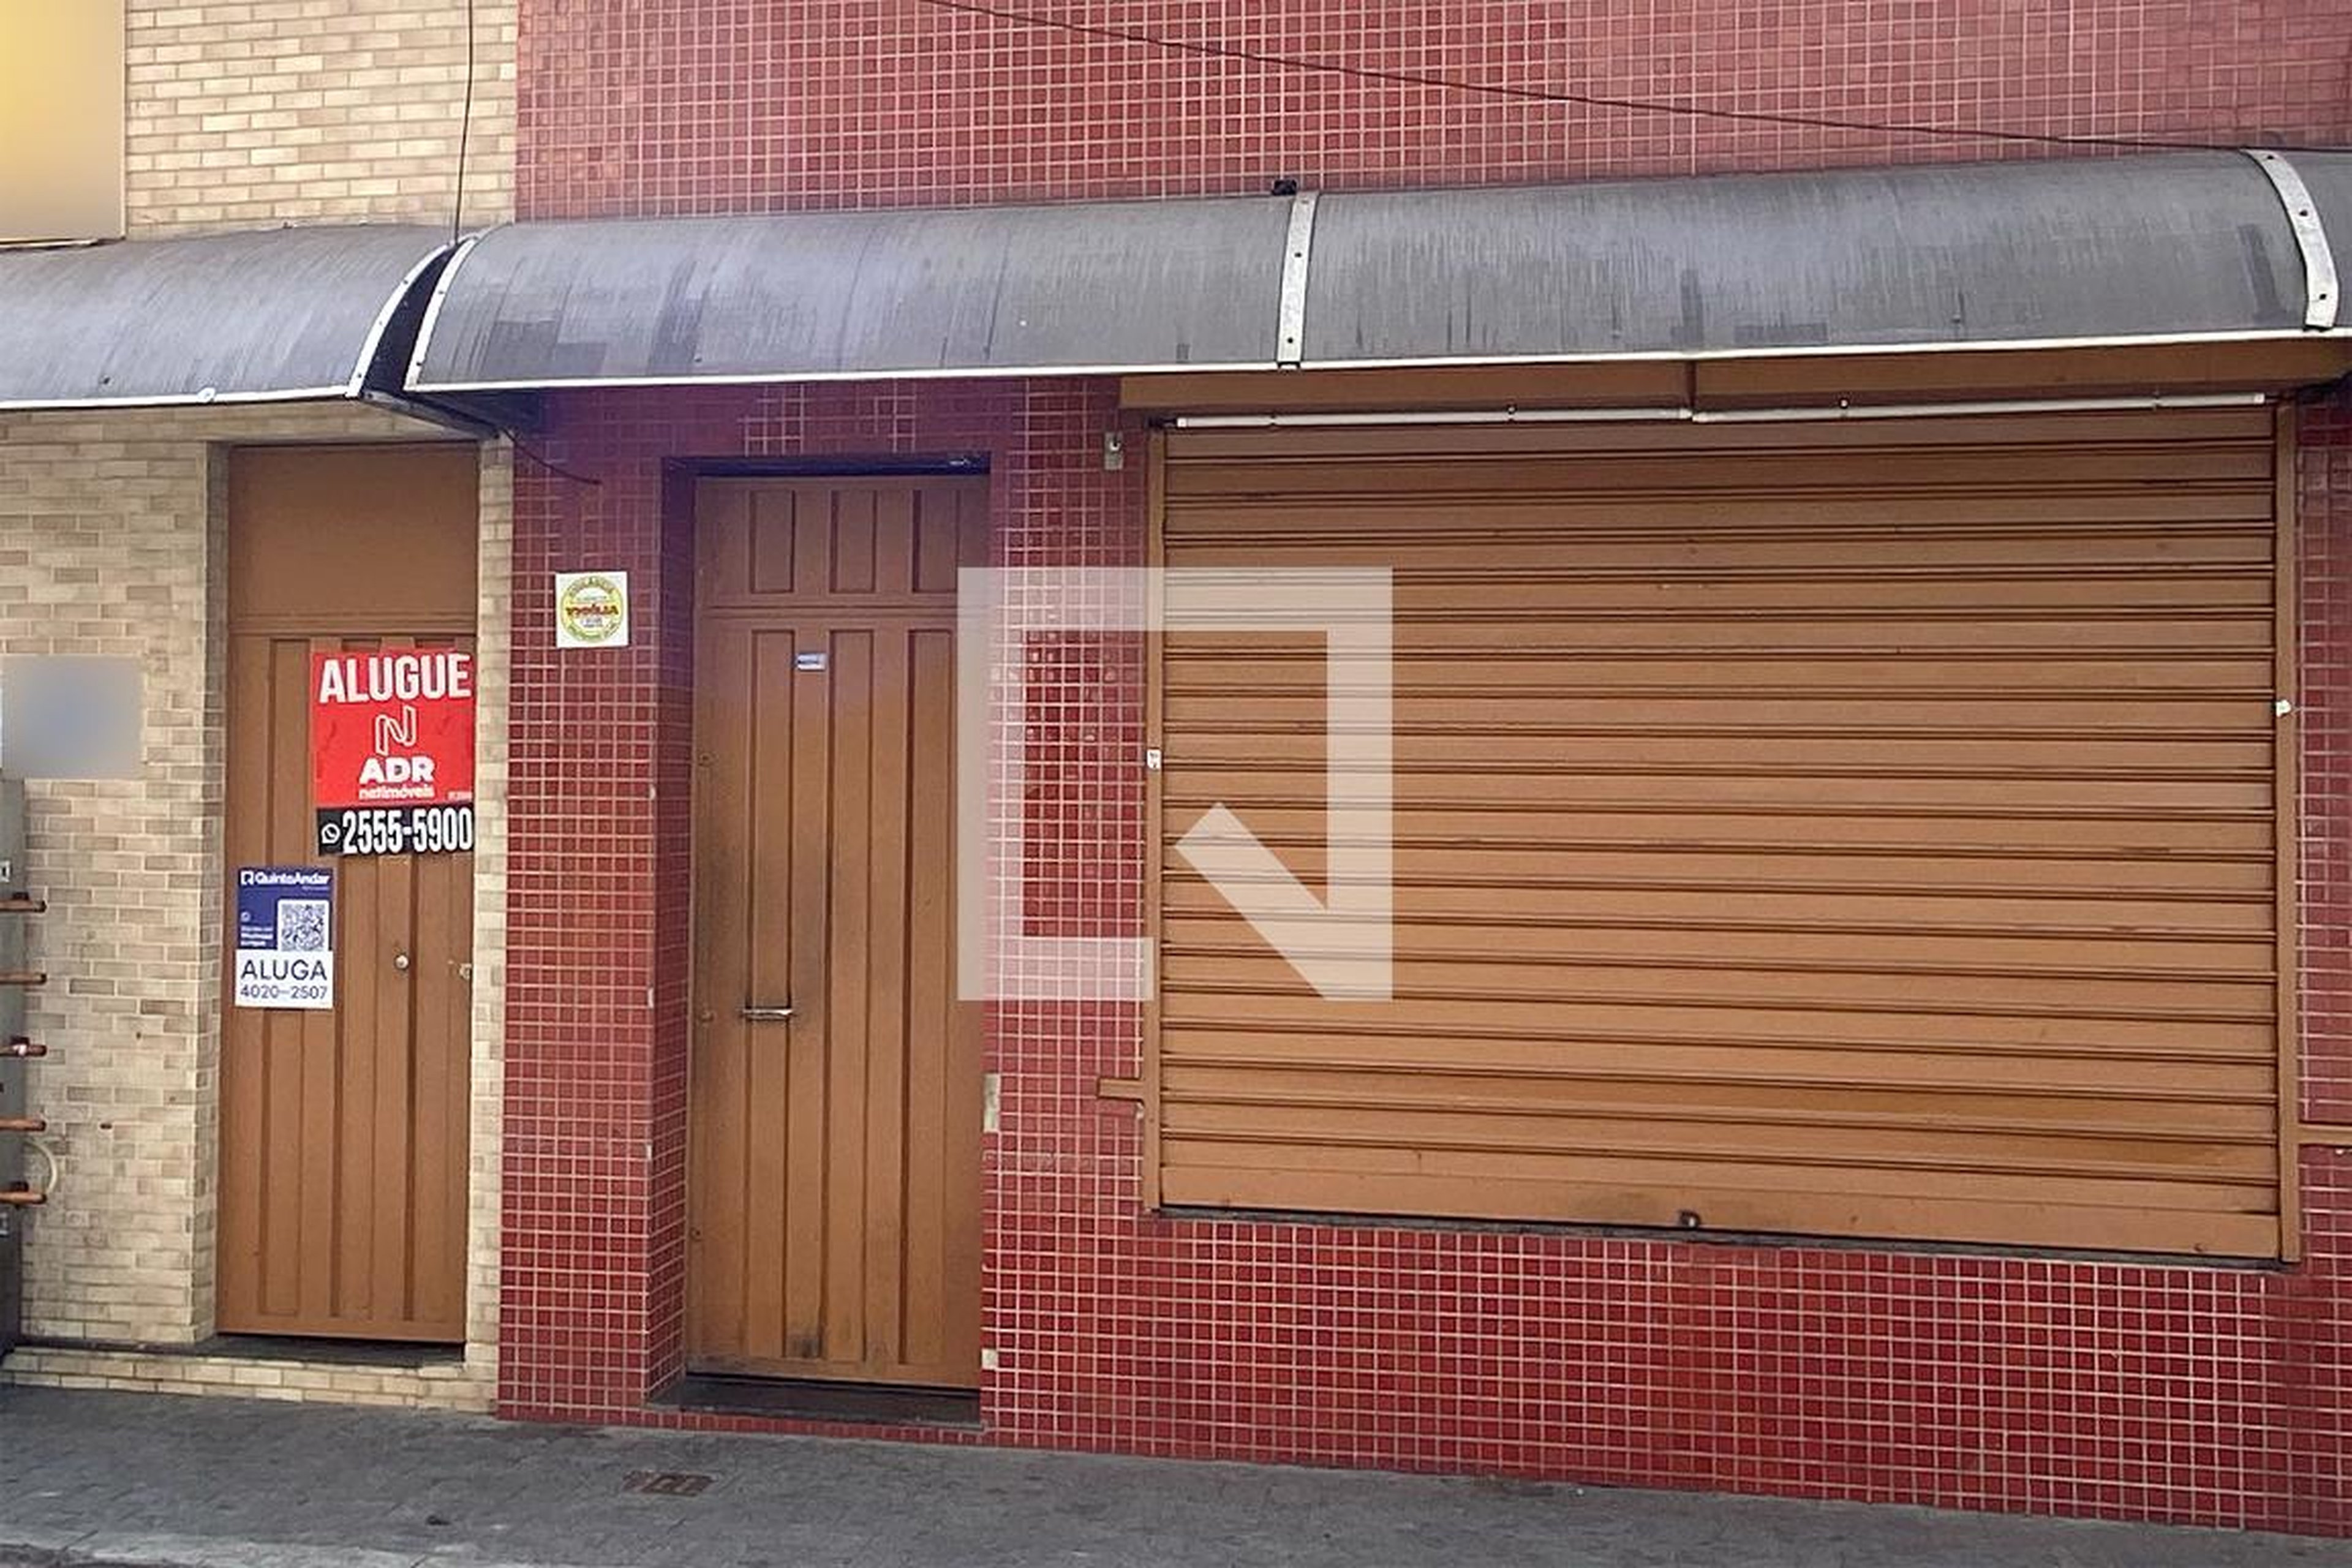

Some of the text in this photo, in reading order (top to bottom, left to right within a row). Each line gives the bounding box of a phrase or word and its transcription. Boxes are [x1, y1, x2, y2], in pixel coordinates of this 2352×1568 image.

[318, 654, 472, 703] ALUGUE
[359, 756, 435, 785] ADR
[342, 807, 474, 854] 2555-5900
[241, 960, 327, 981] ALUGA
[240, 985, 328, 1000] 4020-2507
